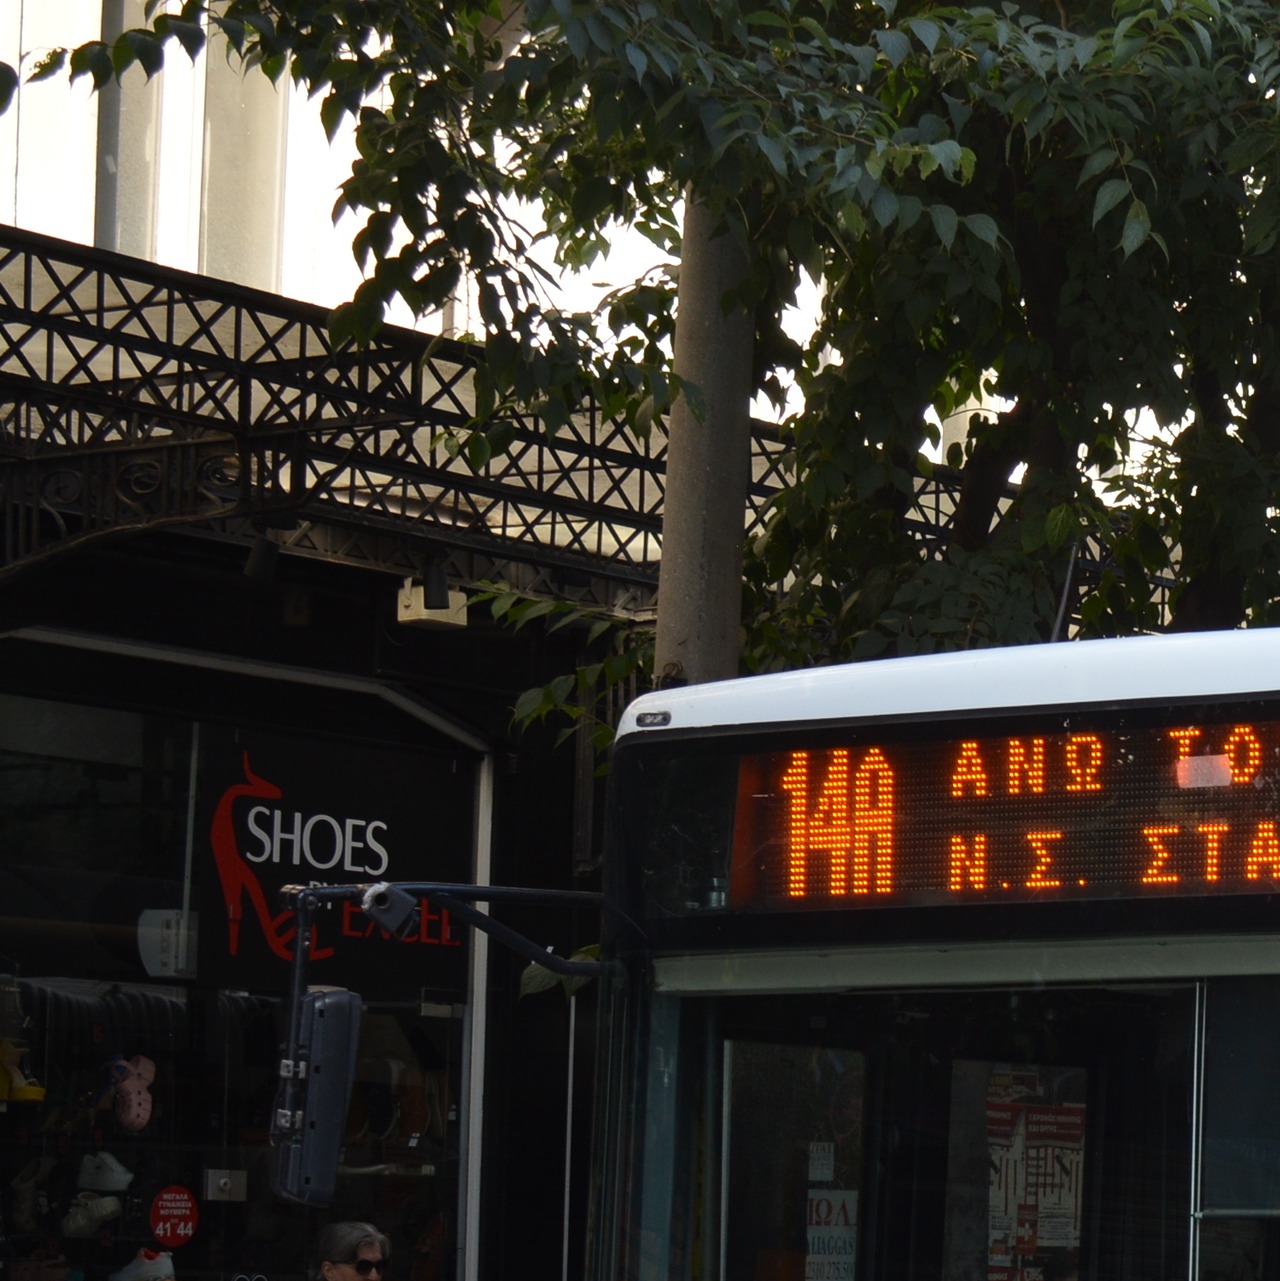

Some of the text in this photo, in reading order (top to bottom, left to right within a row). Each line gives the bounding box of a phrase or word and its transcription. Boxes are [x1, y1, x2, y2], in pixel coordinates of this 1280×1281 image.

[951, 735, 1103, 797] ΑΝΩ
[246, 805, 389, 876] SHOES
[155, 1221, 193, 1237] 41 44
